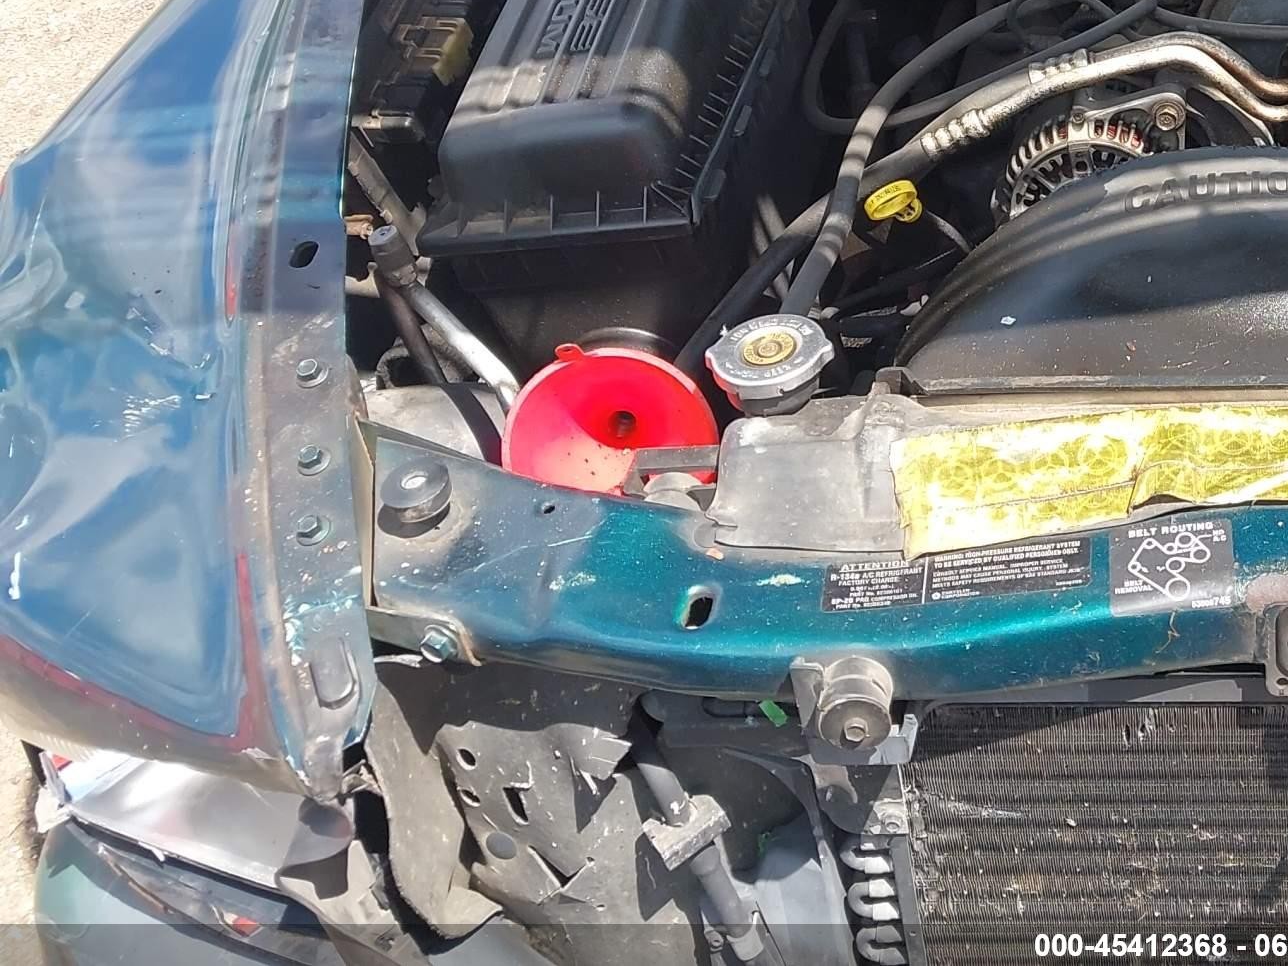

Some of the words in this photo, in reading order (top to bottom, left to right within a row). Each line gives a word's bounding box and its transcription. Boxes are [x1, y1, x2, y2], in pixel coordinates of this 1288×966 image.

[1128, 527, 1158, 538] BELT
[1161, 522, 1213, 535] ROUTING
[965, 547, 1013, 558] HIGH-PRESSURE
[1014, 543, 1055, 553] REFRIGERANT
[1056, 540, 1081, 548] SYSTEM
[840, 561, 909, 572] ATTENTION
[953, 558, 982, 567] SERVICED
[993, 553, 1025, 562] QUALIFIED
[1025, 549, 1061, 558] PERSONNEL
[875, 567, 924, 578] REFRIGERANT
[932, 581, 951, 589] MEETS
[972, 575, 1016, 584] REQUIREMENTS
[1037, 569, 1067, 577] STANDARD
[933, 575, 960, 583] METHODS
[992, 568, 1022, 576] PERSONAL
[1046, 563, 1069, 571] SYSTEM
[1114, 585, 1153, 594] REMOVAL
